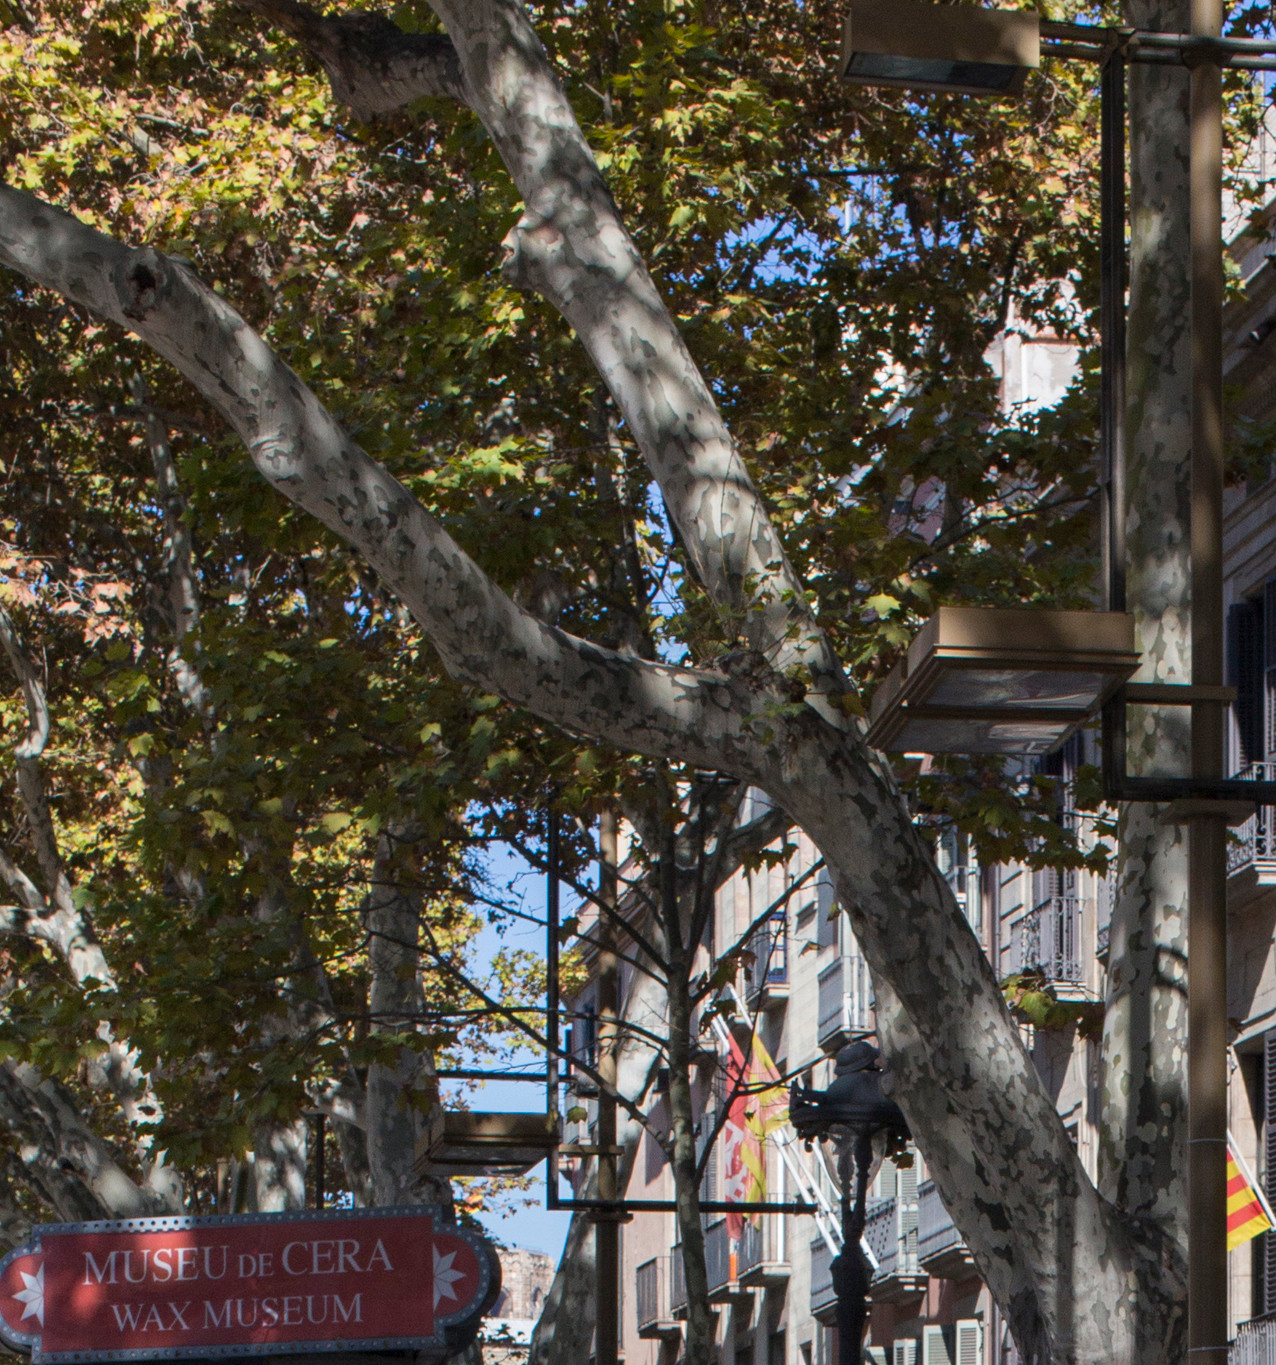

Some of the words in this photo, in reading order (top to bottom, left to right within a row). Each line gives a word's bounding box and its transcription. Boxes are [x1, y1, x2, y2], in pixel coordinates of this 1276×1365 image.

[82, 1245, 229, 1286] MUSEU
[238, 1252, 276, 1279] DE
[281, 1238, 395, 1276] CERA
[112, 1300, 192, 1333] WAX
[202, 1293, 364, 1330] MUSEUM
